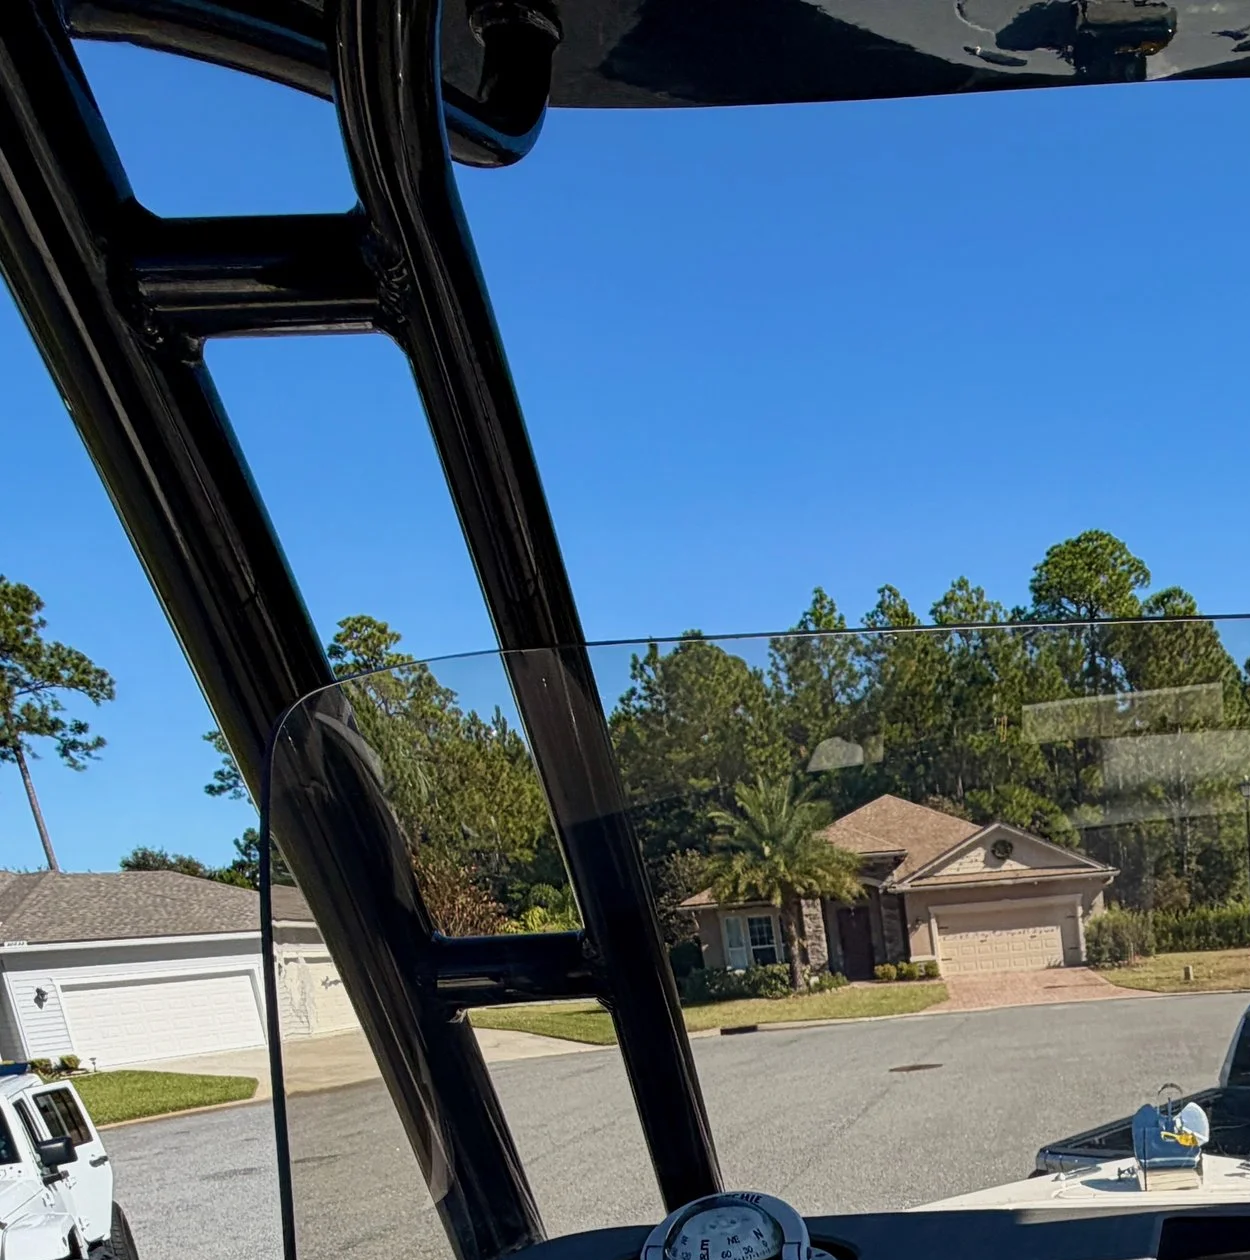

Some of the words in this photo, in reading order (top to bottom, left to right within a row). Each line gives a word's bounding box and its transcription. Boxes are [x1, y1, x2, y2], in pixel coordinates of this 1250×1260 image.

[753, 1228, 764, 1240] N
[700, 1239, 710, 1251] E
[721, 1249, 732, 1259] 60
